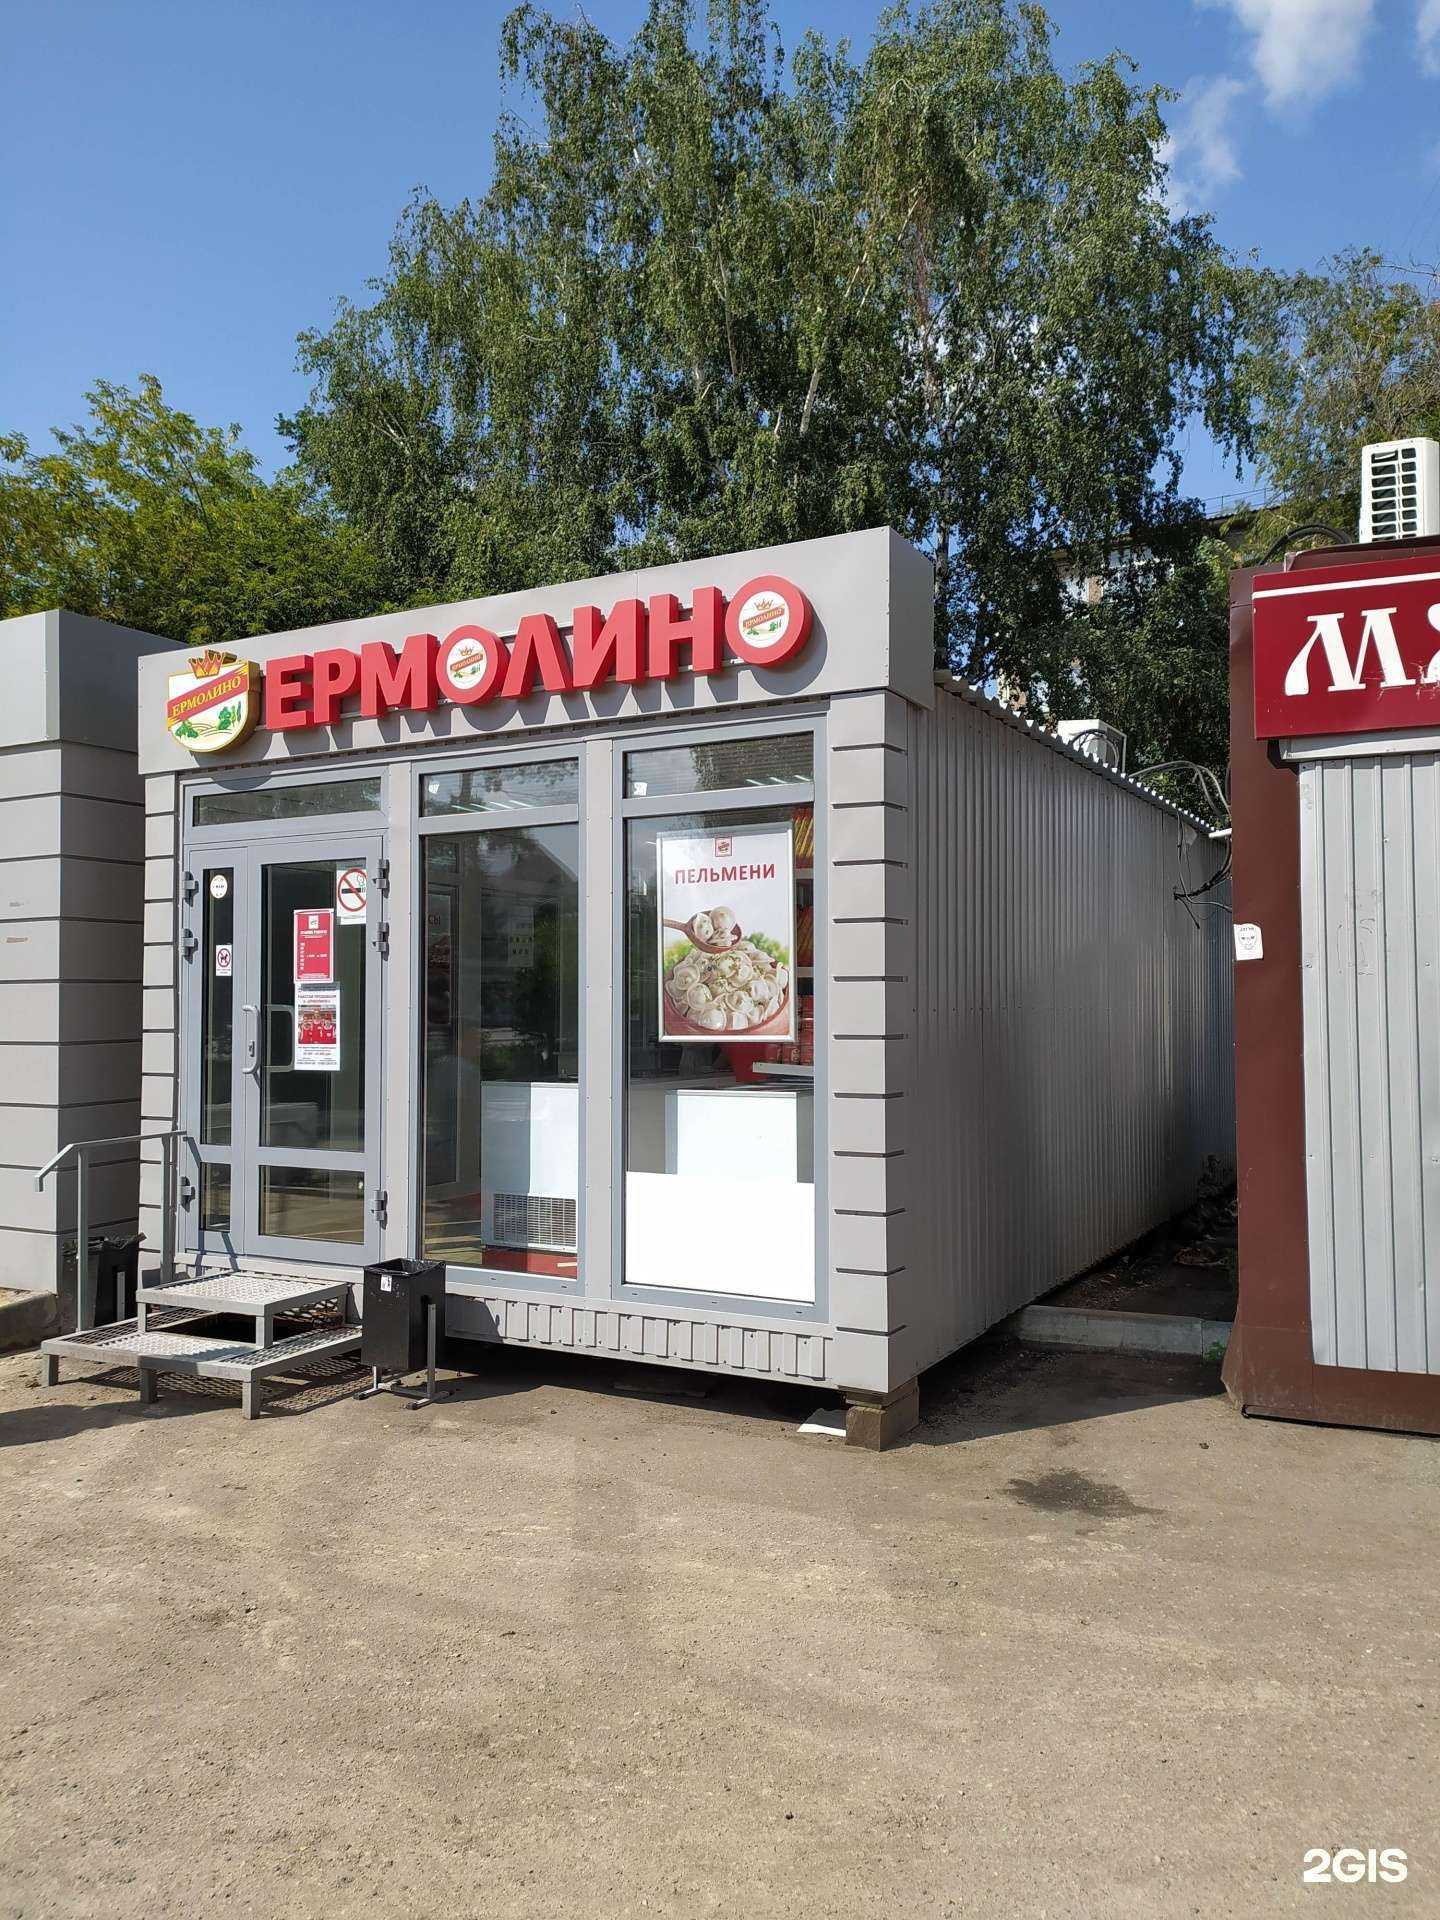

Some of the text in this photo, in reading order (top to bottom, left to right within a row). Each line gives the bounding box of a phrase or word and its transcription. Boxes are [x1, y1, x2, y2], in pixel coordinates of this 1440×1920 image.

[264, 575, 809, 731] ЕРМОЛИНО
[172, 676, 241, 716] ЕРМОЛИНО
[675, 863, 776, 885] ПЕЛЬМЕНИ
